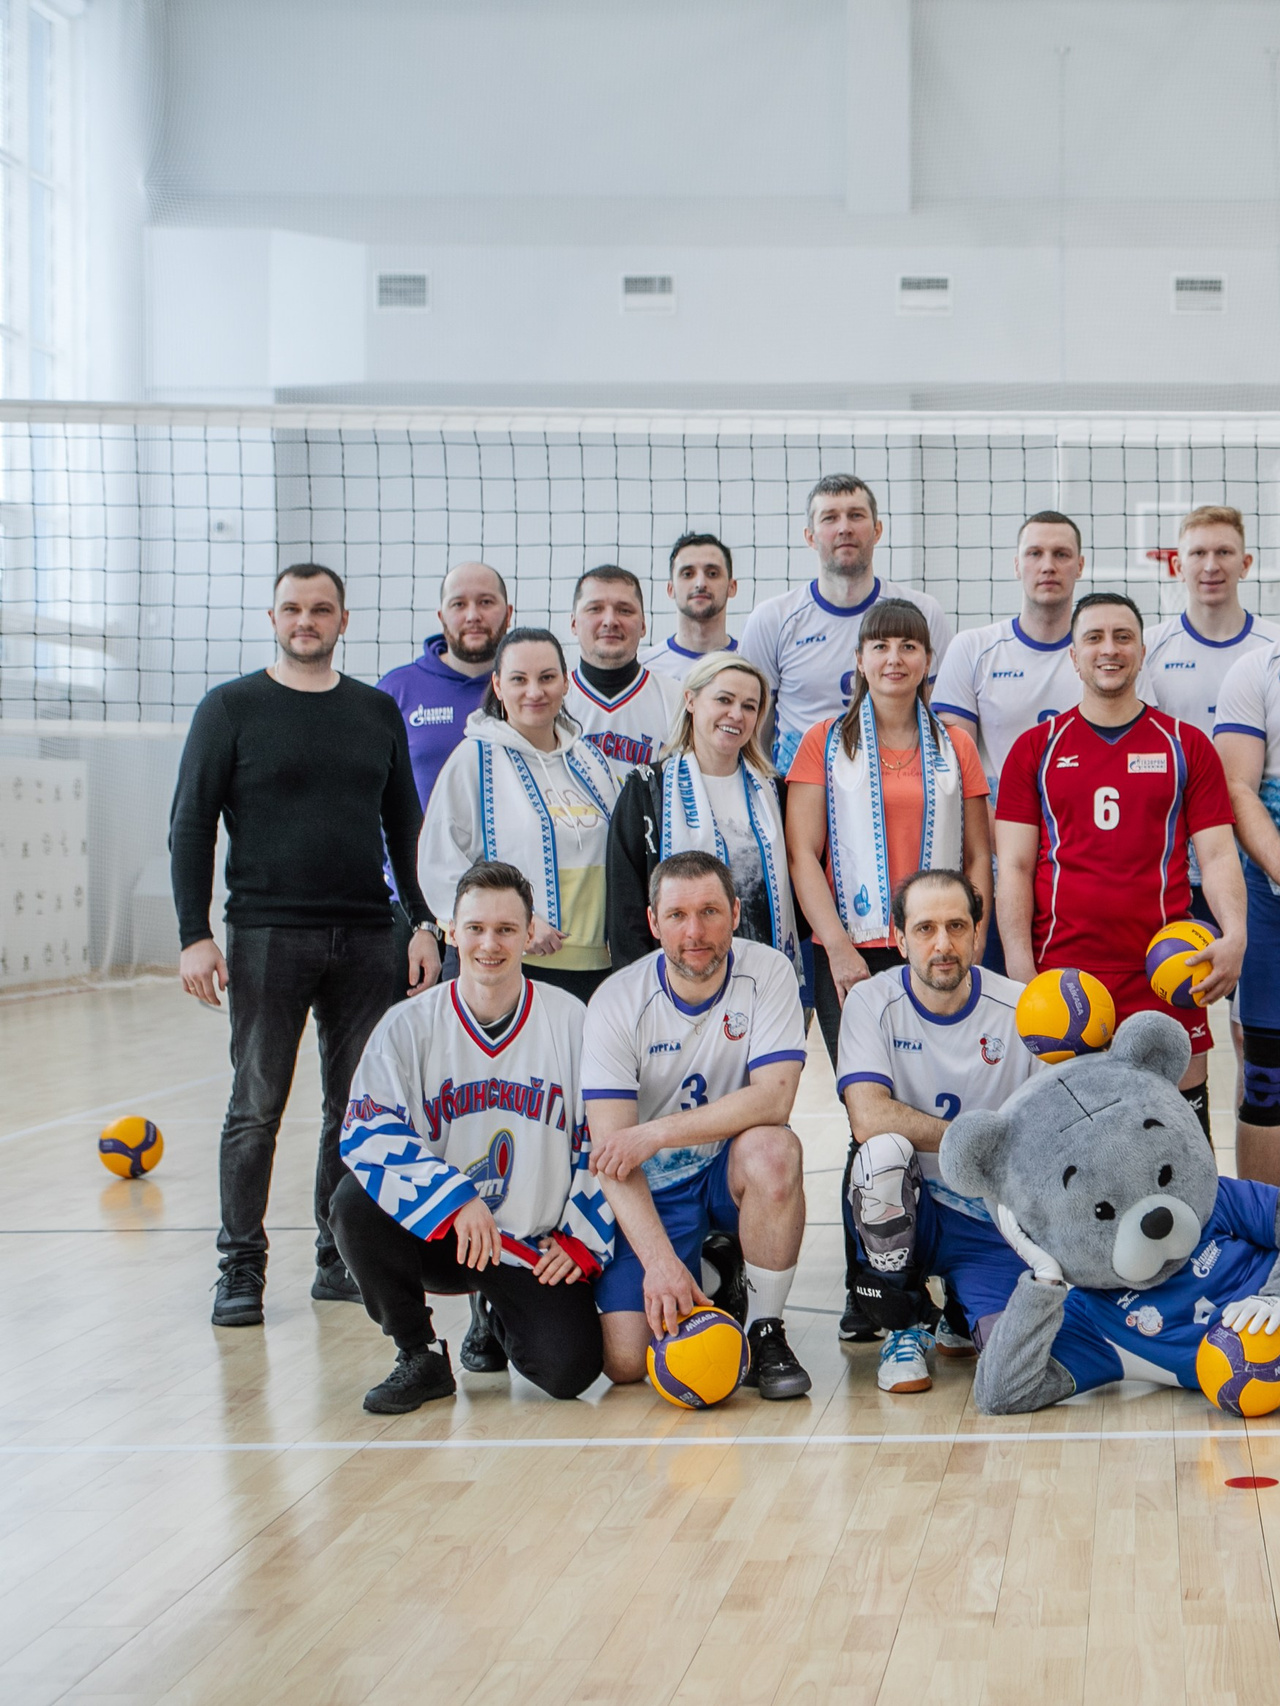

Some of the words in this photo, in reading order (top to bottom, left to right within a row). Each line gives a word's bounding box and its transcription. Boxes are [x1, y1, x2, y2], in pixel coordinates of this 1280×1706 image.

[1094, 786, 1120, 831] 6
[680, 1072, 709, 1111] 3
[856, 1285, 882, 1298] ALLSIX
